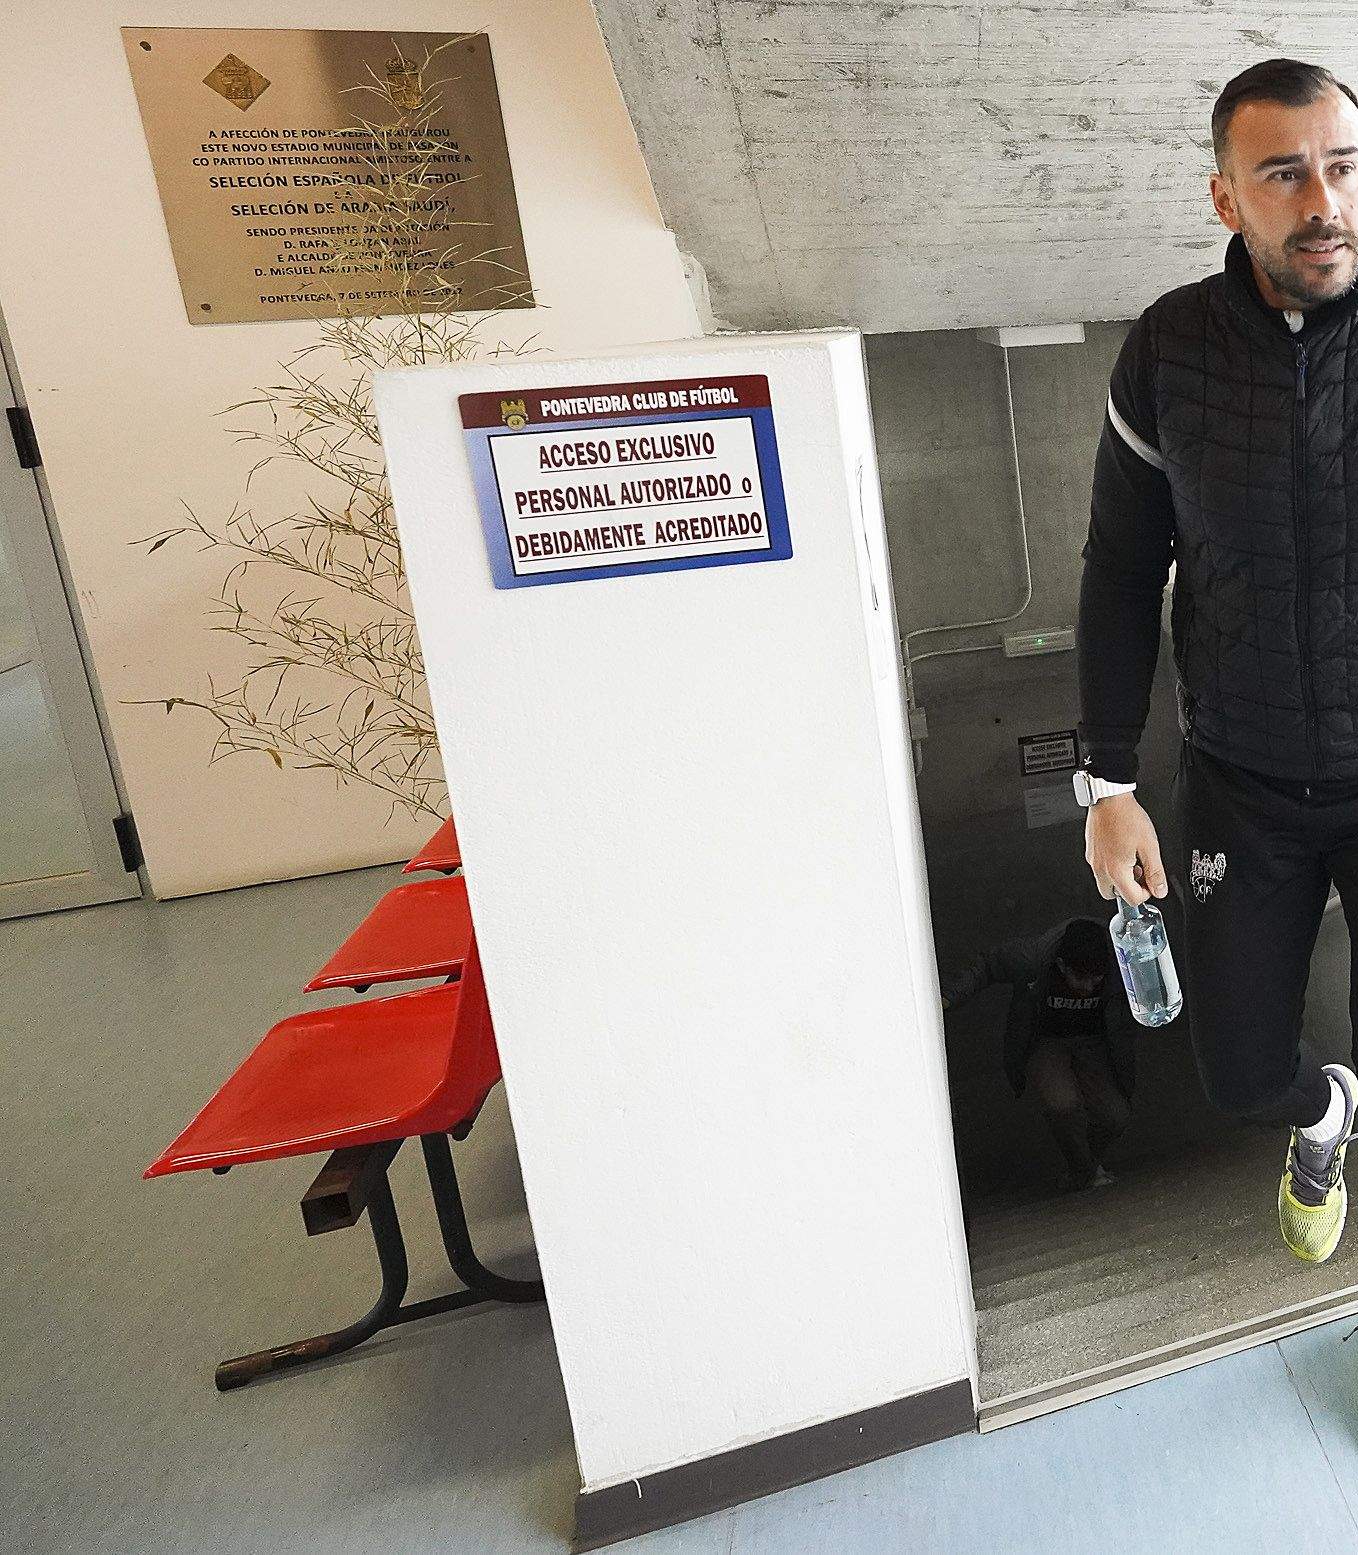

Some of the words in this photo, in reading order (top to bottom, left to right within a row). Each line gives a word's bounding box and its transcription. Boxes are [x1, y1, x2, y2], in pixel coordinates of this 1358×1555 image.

[208, 130, 218, 138] A
[220, 128, 279, 138] AFECCIÓN
[282, 130, 298, 138] DE
[201, 144, 229, 152] ESTE
[232, 143, 268, 152] NOVO
[271, 143, 320, 152] ESTADIO
[323, 142, 384, 152] MUNICIPA
[192, 157, 209, 166] CO
[213, 156, 265, 166] PARTIDO
[268, 155, 360, 165] INTERNACIONAL
[209, 172, 288, 188] SELECIÓN
[293, 171, 376, 187] ESPAÑOLA
[231, 199, 309, 216] SELECIÓN
[314, 202, 334, 214] DE
[246, 227, 287, 237] SENDO
[290, 225, 357, 236] PRESIDENTE
[541, 395, 631, 417] PONTEVEDRA
[633, 391, 669, 411] CLUB
[671, 390, 687, 408] DE
[690, 385, 739, 405] FÚTBOL
[539, 439, 612, 469] ACCESO
[617, 432, 715, 462] EXCLUSIVO
[515, 482, 616, 514] PERSONAL
[621, 473, 731, 506] AUTORIZADO
[515, 523, 646, 558] DEBIDAMENTE
[655, 511, 762, 543] ACREDITADO
